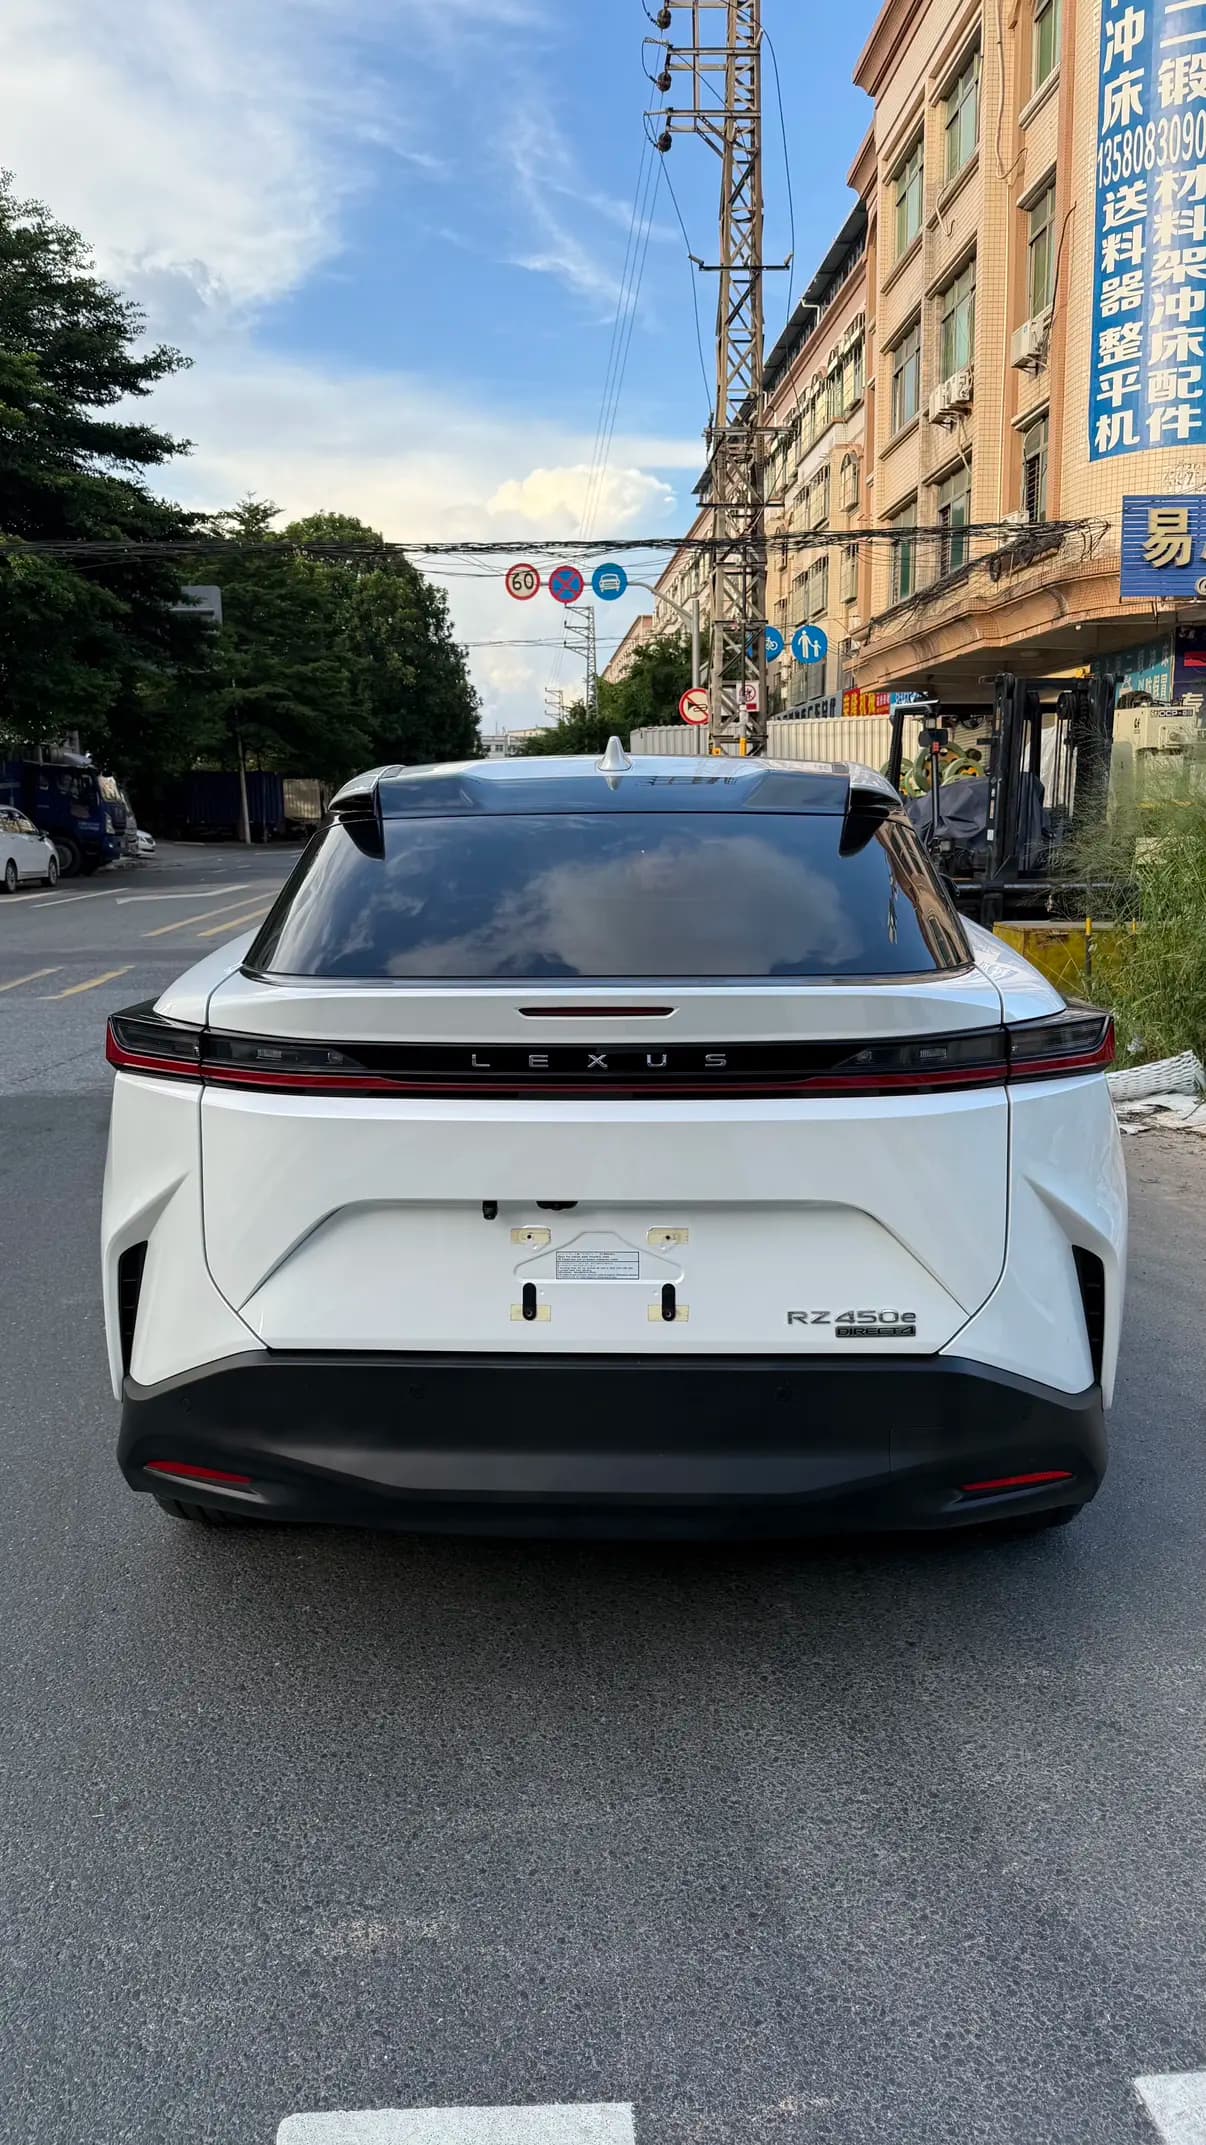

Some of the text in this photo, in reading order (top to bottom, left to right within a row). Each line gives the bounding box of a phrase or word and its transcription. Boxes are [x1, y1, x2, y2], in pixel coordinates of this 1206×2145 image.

[1102, 0, 1145, 136] 冲床
[1095, 179, 1148, 453] 送料器整平机
[1146, 164, 1206, 442] 材料架冲床配件
[512, 572, 534, 590] 60
[1142, 508, 1206, 569] 易
[471, 1053, 727, 1068] LEXUS
